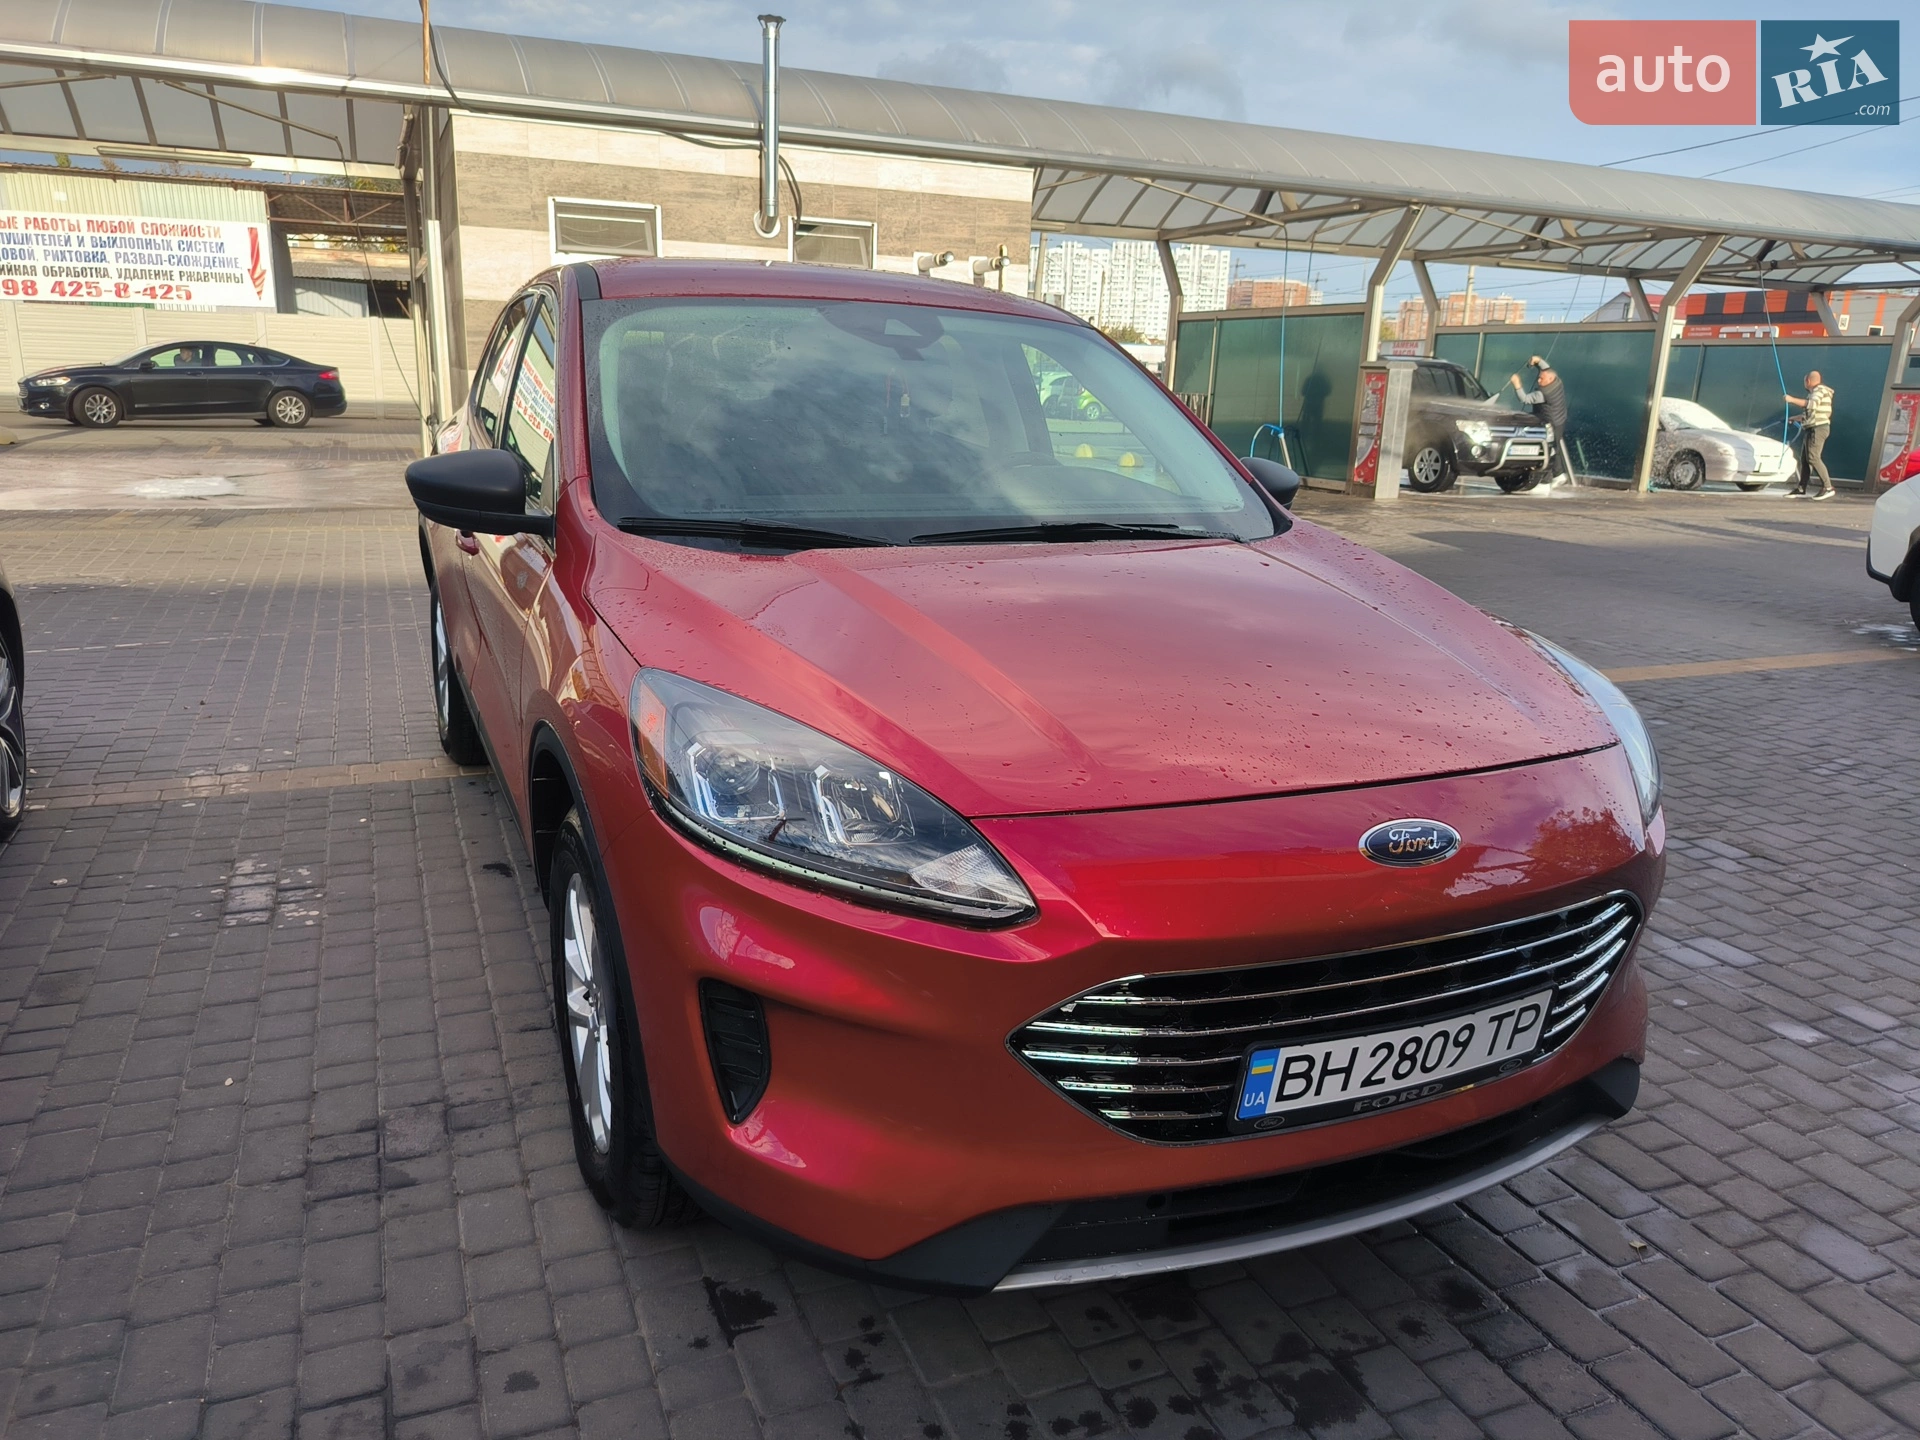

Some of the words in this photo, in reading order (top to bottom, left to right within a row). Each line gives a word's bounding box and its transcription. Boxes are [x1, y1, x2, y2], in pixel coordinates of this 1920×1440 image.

[24, 216, 82, 233] РАБОТЫ
[86, 218, 136, 235] ЛЮБОЙ
[141, 221, 222, 239] СЛОЖНОСТИ
[77, 235, 86, 248] И
[90, 236, 173, 252] ВЫХЛОПНЫХ
[177, 240, 225, 254] СИСТЕМ
[116, 267, 175, 281] УДАЛЕНИЕ
[178, 270, 244, 284] РЖАВЧИНЫ
[50, 281, 192, 301] 425-8-425
[1388, 826, 1442, 853] Ford
[1275, 1046, 1360, 1103] BH
[1360, 1022, 1477, 1089] 2809
[1486, 1003, 1541, 1057] TP
[1244, 1091, 1265, 1107] UA
[1353, 1083, 1444, 1112] FORD
